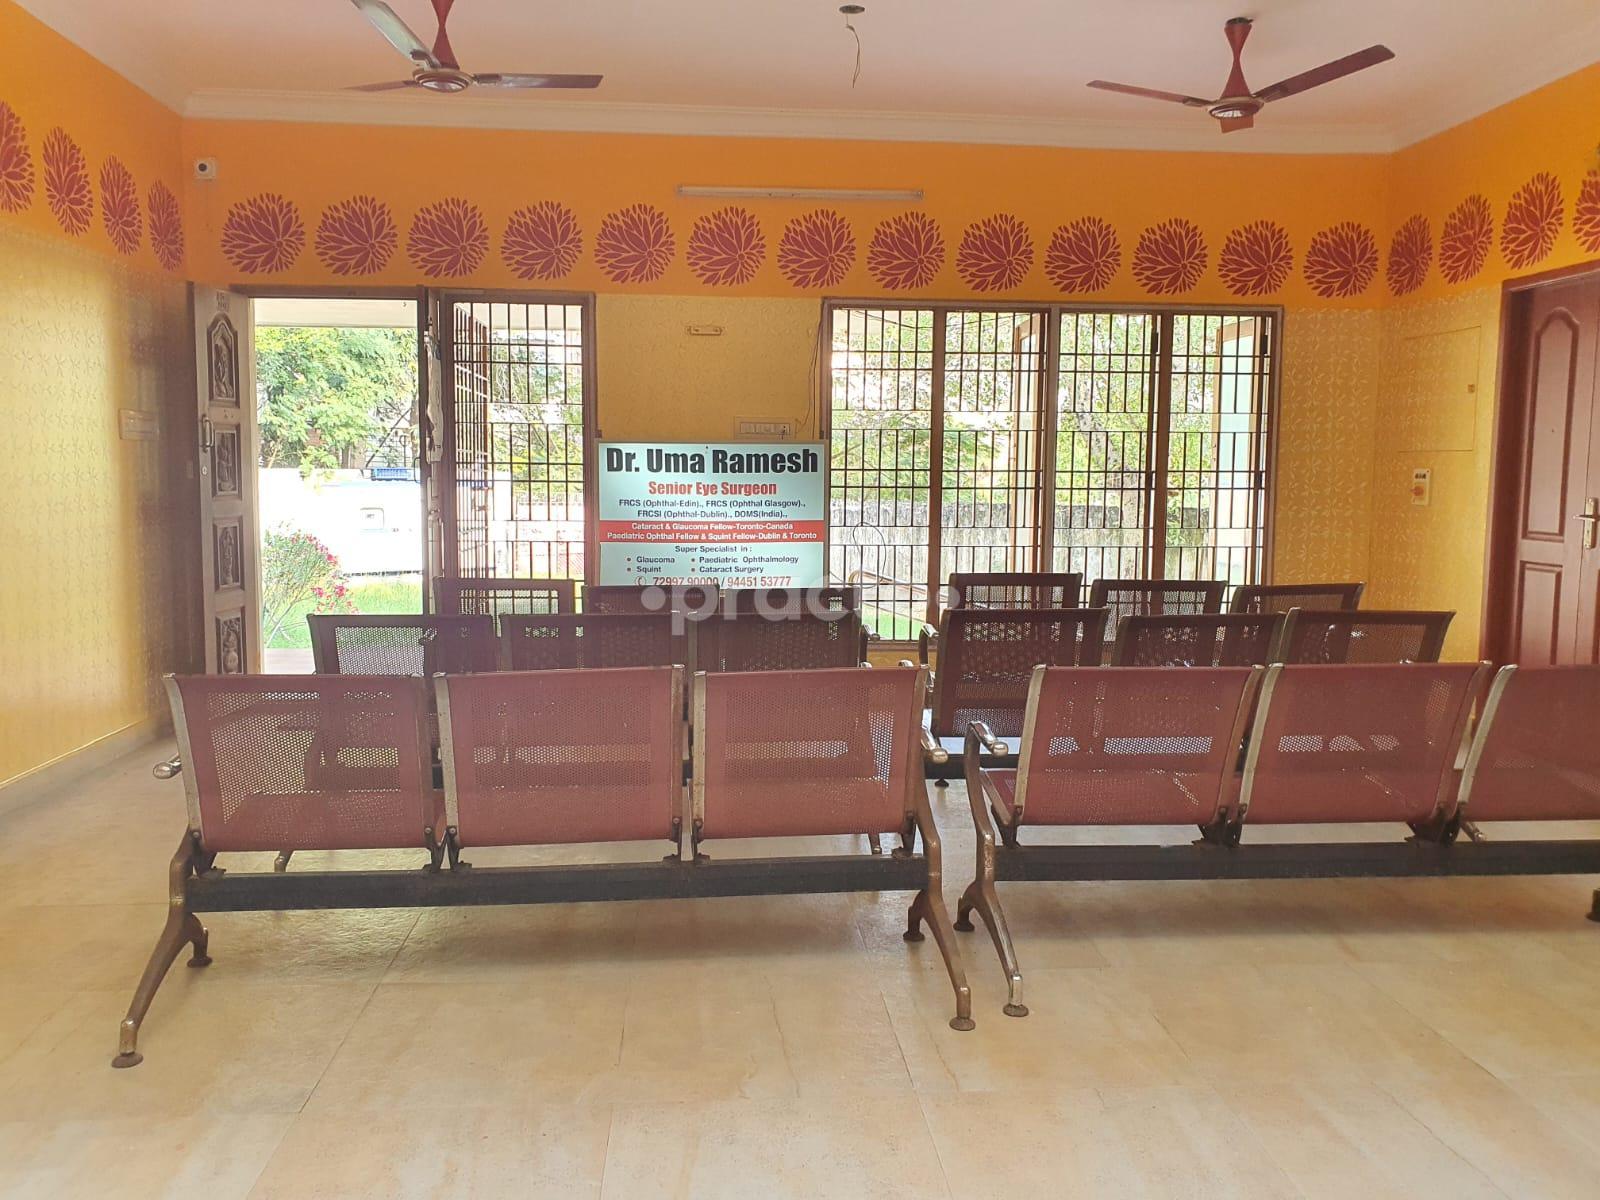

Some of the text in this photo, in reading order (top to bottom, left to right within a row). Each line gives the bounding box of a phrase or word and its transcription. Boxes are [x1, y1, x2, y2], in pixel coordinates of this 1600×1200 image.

[607, 448, 818, 473] Dr. Uma Ramesh
[648, 481, 777, 496] Senior Eye Surgeon
[706, 499, 728, 507] FRCS
[729, 499, 763, 508] (Ophthal
[637, 510, 662, 518] FRCSI
[631, 522, 664, 530] Cataract
[672, 522, 709, 530] Glaucoma
[709, 522, 794, 530] Fellow-Toronto-Canada
[607, 532, 645, 540] Paediatric
[646, 532, 674, 541] Ophthal
[675, 532, 699, 540] Fellow
[700, 532, 707, 540] &
[707, 532, 732, 541] Squint
[732, 532, 781, 540] Fellow-Dublin
[674, 545, 698, 554] Super
[699, 545, 737, 553] Specialist
[742, 556, 799, 564] Ophthalmology
[636, 565, 662, 574] Squint
[734, 566, 764, 574] Surgery
[727, 576, 757, 587] 94451
[760, 576, 792, 587] 53777
